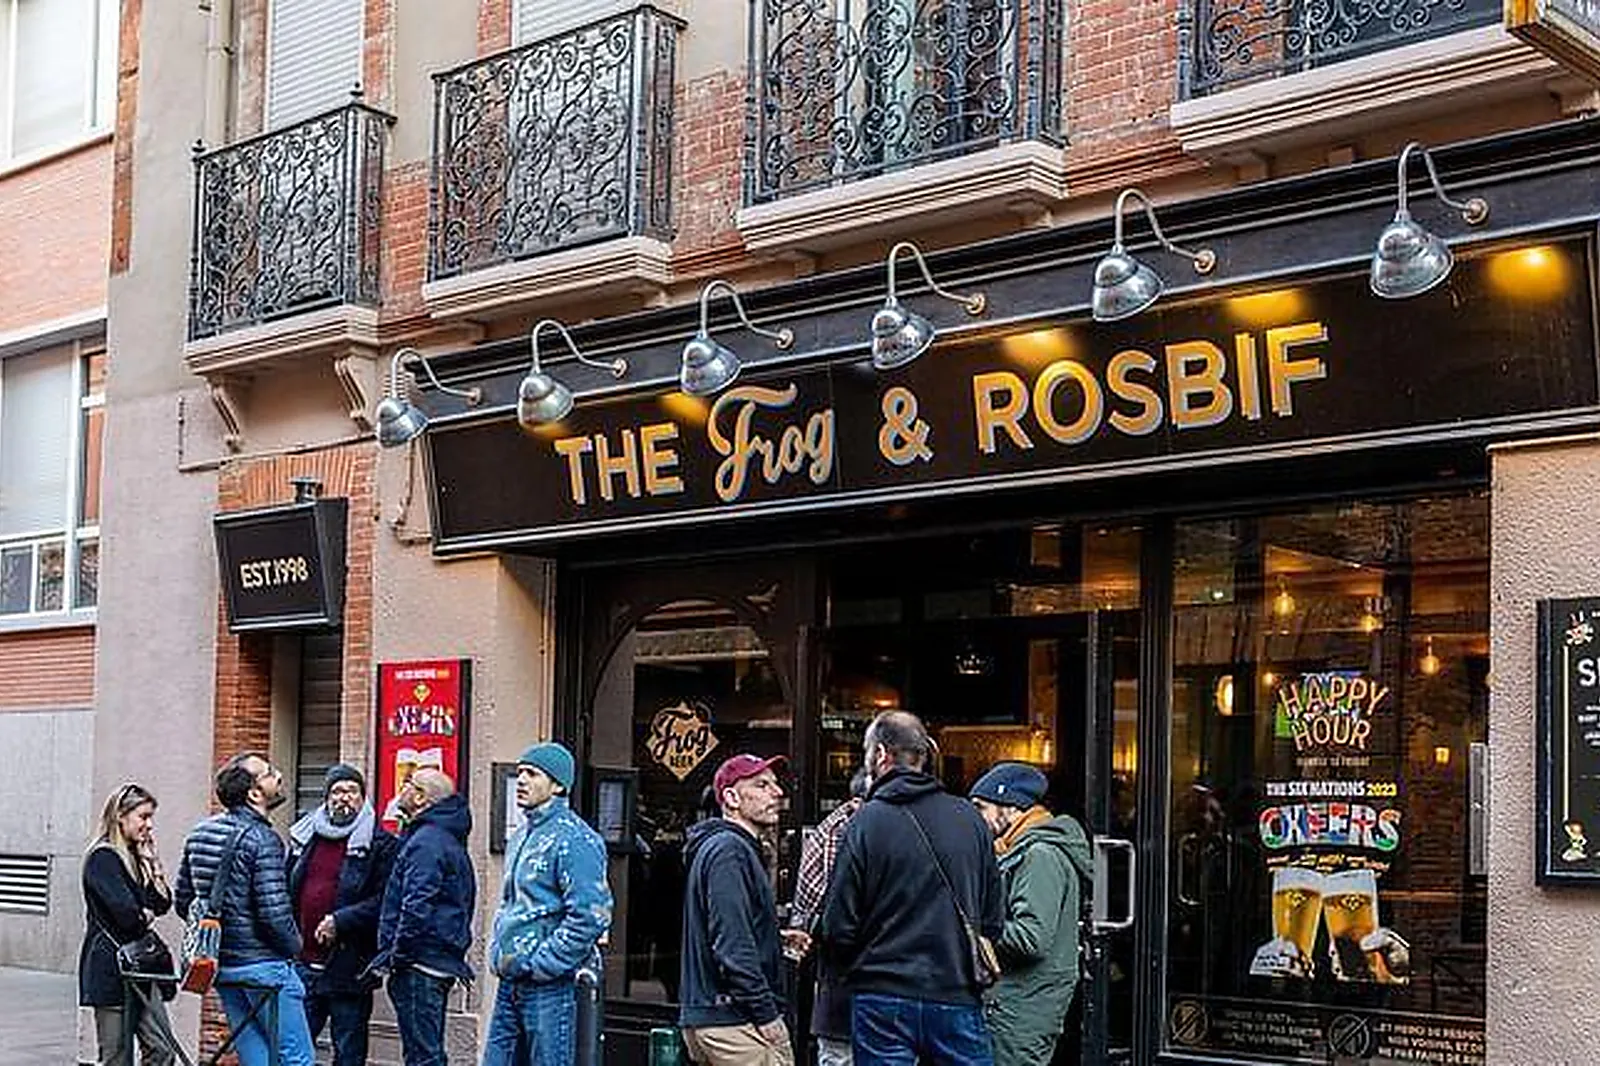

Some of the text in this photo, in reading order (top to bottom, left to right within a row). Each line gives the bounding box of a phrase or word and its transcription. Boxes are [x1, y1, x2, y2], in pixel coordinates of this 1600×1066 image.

[554, 322, 1328, 505] THE Frog & ROSBIF
[1277, 676, 1389, 716] HAPPY
[652, 708, 710, 761] Frog
[1291, 715, 1372, 751] HOUR
[1309, 780, 1365, 797] NATIONS
[1259, 803, 1402, 849] CHEERS
